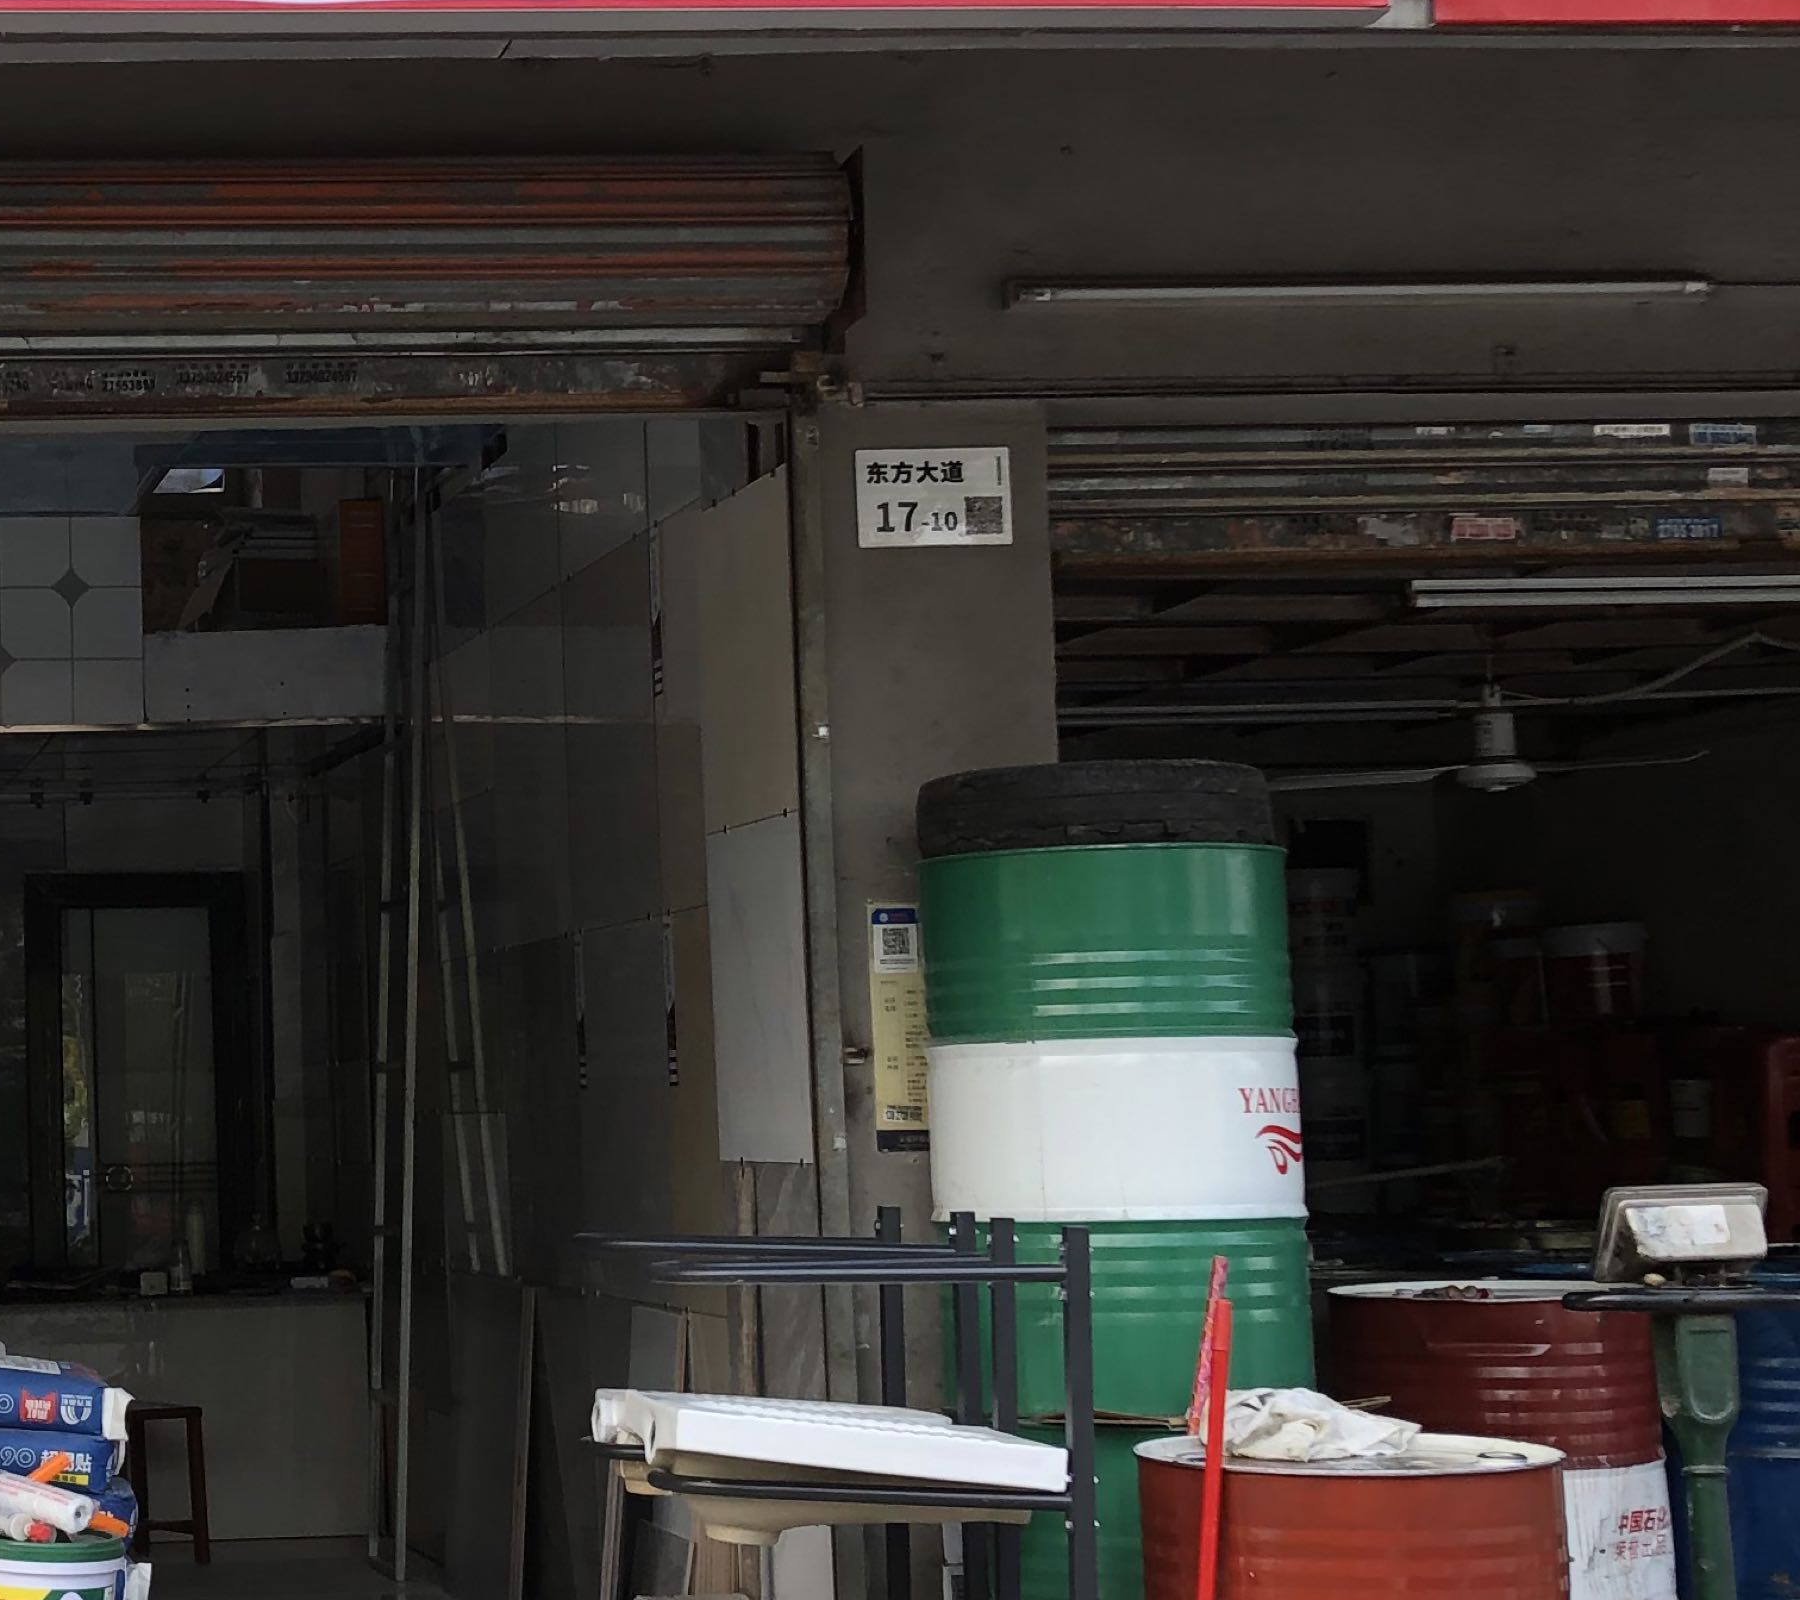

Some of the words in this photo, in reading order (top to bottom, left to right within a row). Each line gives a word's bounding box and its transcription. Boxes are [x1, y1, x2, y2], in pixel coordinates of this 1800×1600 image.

[866, 460, 964, 484] 东方大道
[876, 501, 958, 533] 17-10
[1237, 1087, 1300, 1114] YANG
